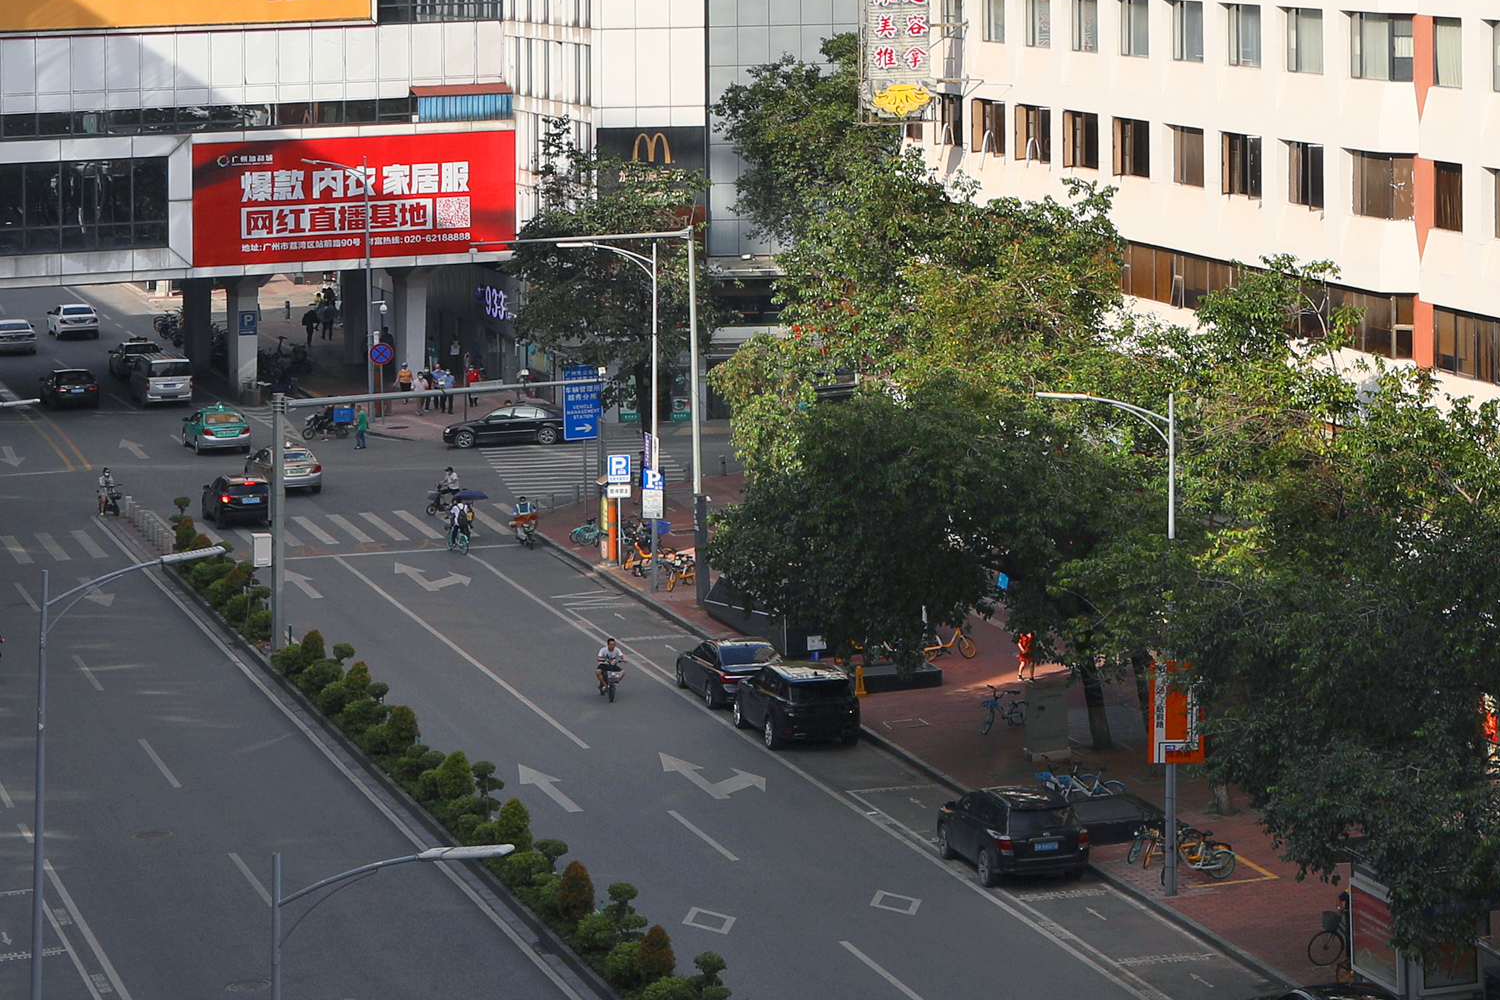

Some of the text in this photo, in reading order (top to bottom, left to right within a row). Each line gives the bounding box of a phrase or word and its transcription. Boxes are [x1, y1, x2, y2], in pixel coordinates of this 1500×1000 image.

[876, 15, 927, 36] 美容
[875, 47, 927, 68] 推拿
[241, 161, 470, 202] 爆款 内衣 家居服
[246, 202, 427, 235] 网红直播基地
[485, 286, 505, 320] 933
